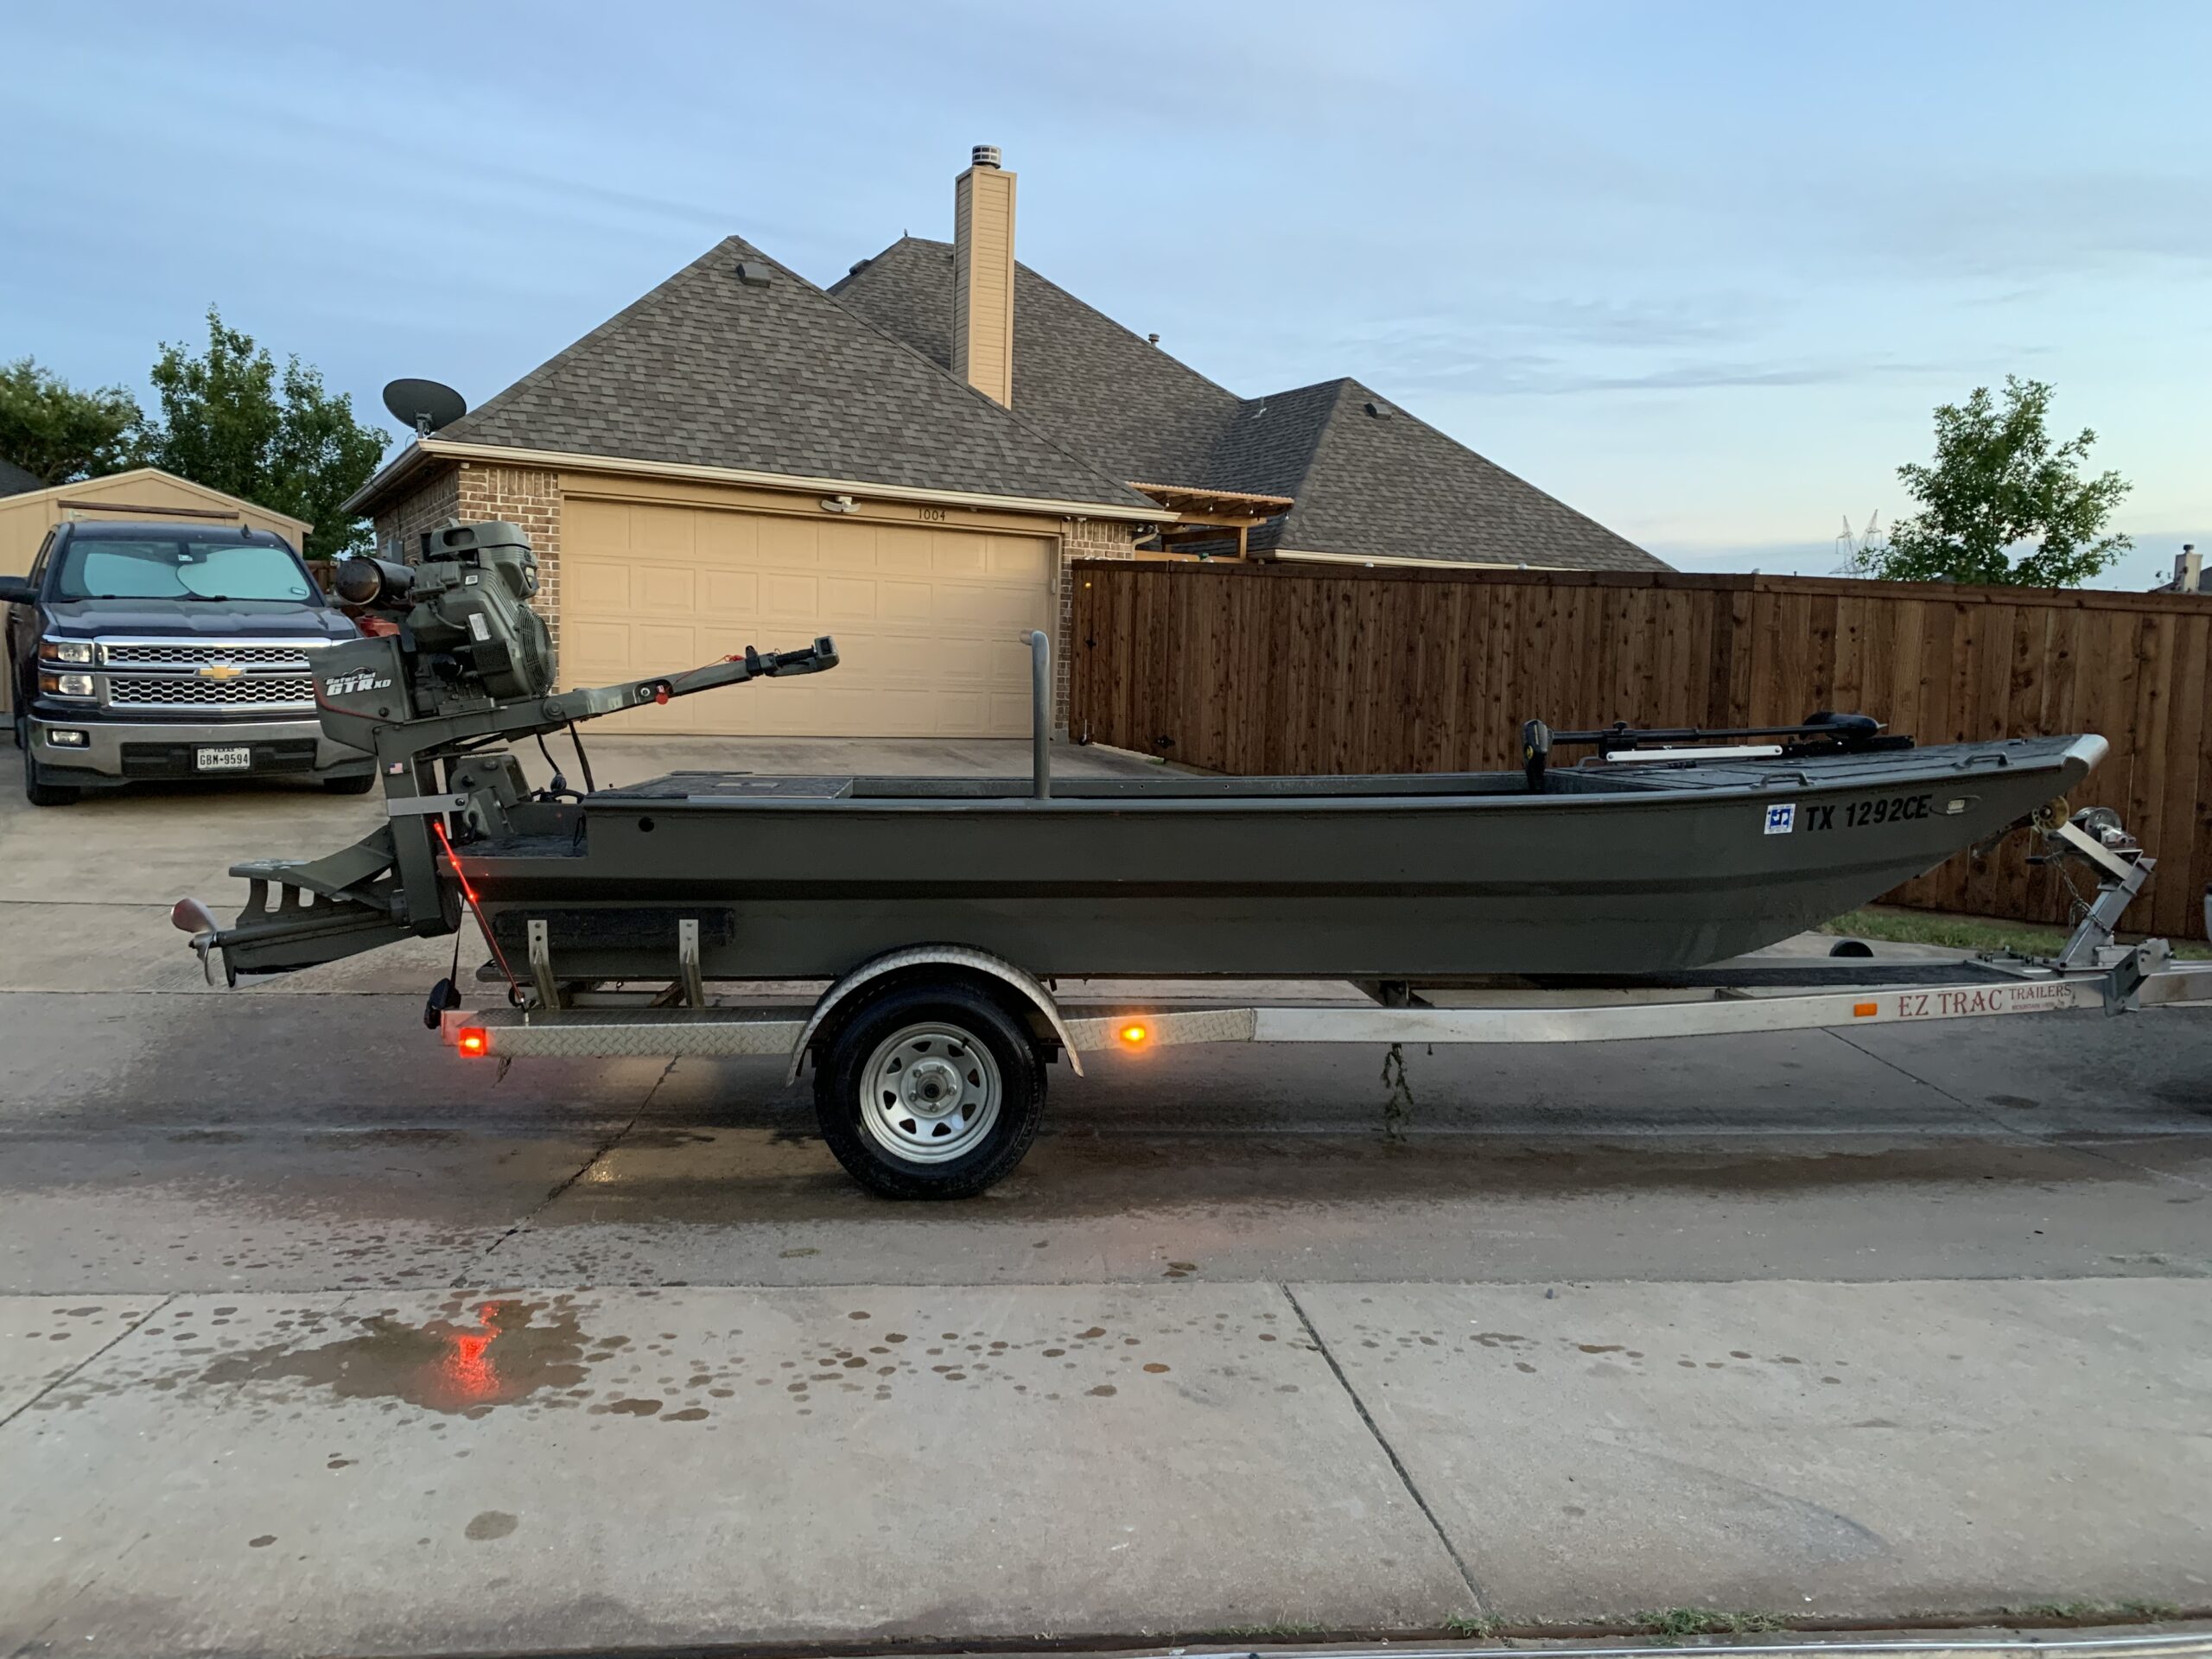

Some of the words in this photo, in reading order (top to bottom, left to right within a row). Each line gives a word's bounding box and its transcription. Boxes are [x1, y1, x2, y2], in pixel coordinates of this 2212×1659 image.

[918, 508, 945, 521] 1004
[327, 678, 373, 696] GTR
[1806, 804, 1836, 831] TX
[1846, 794, 1933, 828] 1292CE
[1898, 995, 1929, 1017] EZ
[1937, 988, 2003, 1014] TRAC
[2008, 985, 2072, 1001] TRAILERS
